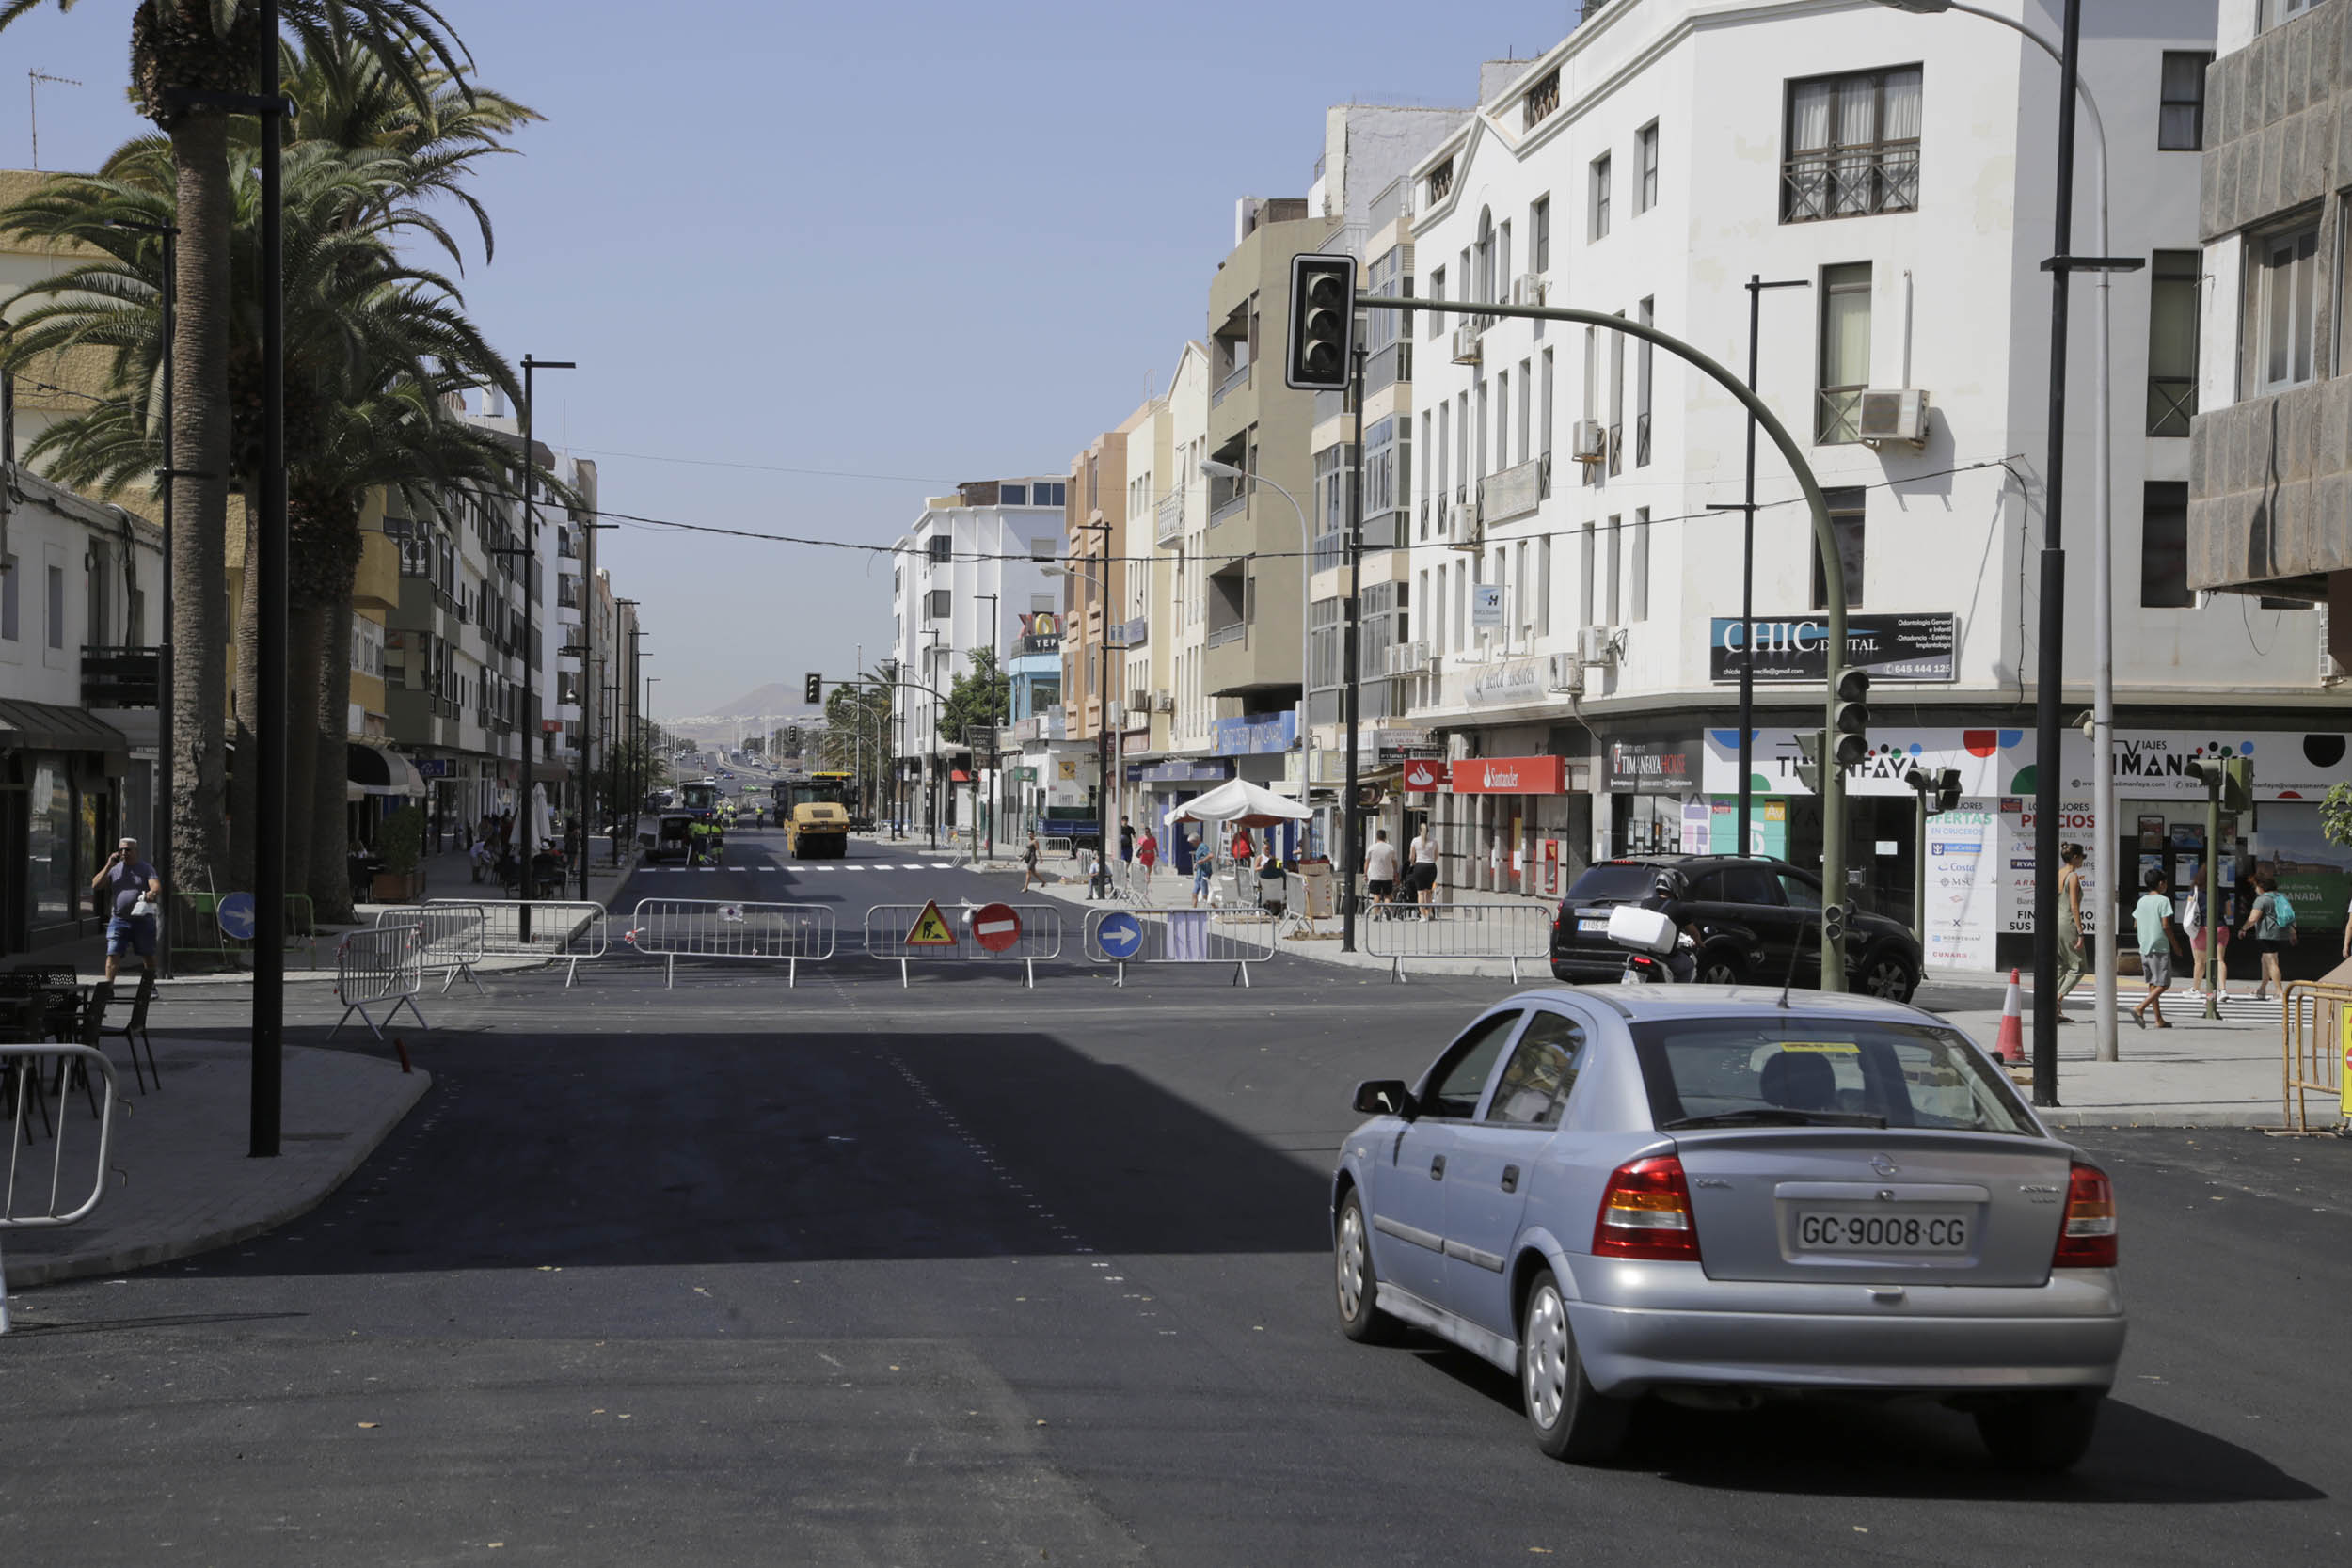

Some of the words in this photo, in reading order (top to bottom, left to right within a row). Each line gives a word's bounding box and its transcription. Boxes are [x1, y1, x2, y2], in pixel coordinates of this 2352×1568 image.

[1724, 621, 1818, 653] CHIC
[1914, 664, 1931, 673] 444
[1933, 664, 1951, 673] 125
[1491, 765, 1518, 787] Santander
[2009, 922, 2032, 931] SUS
